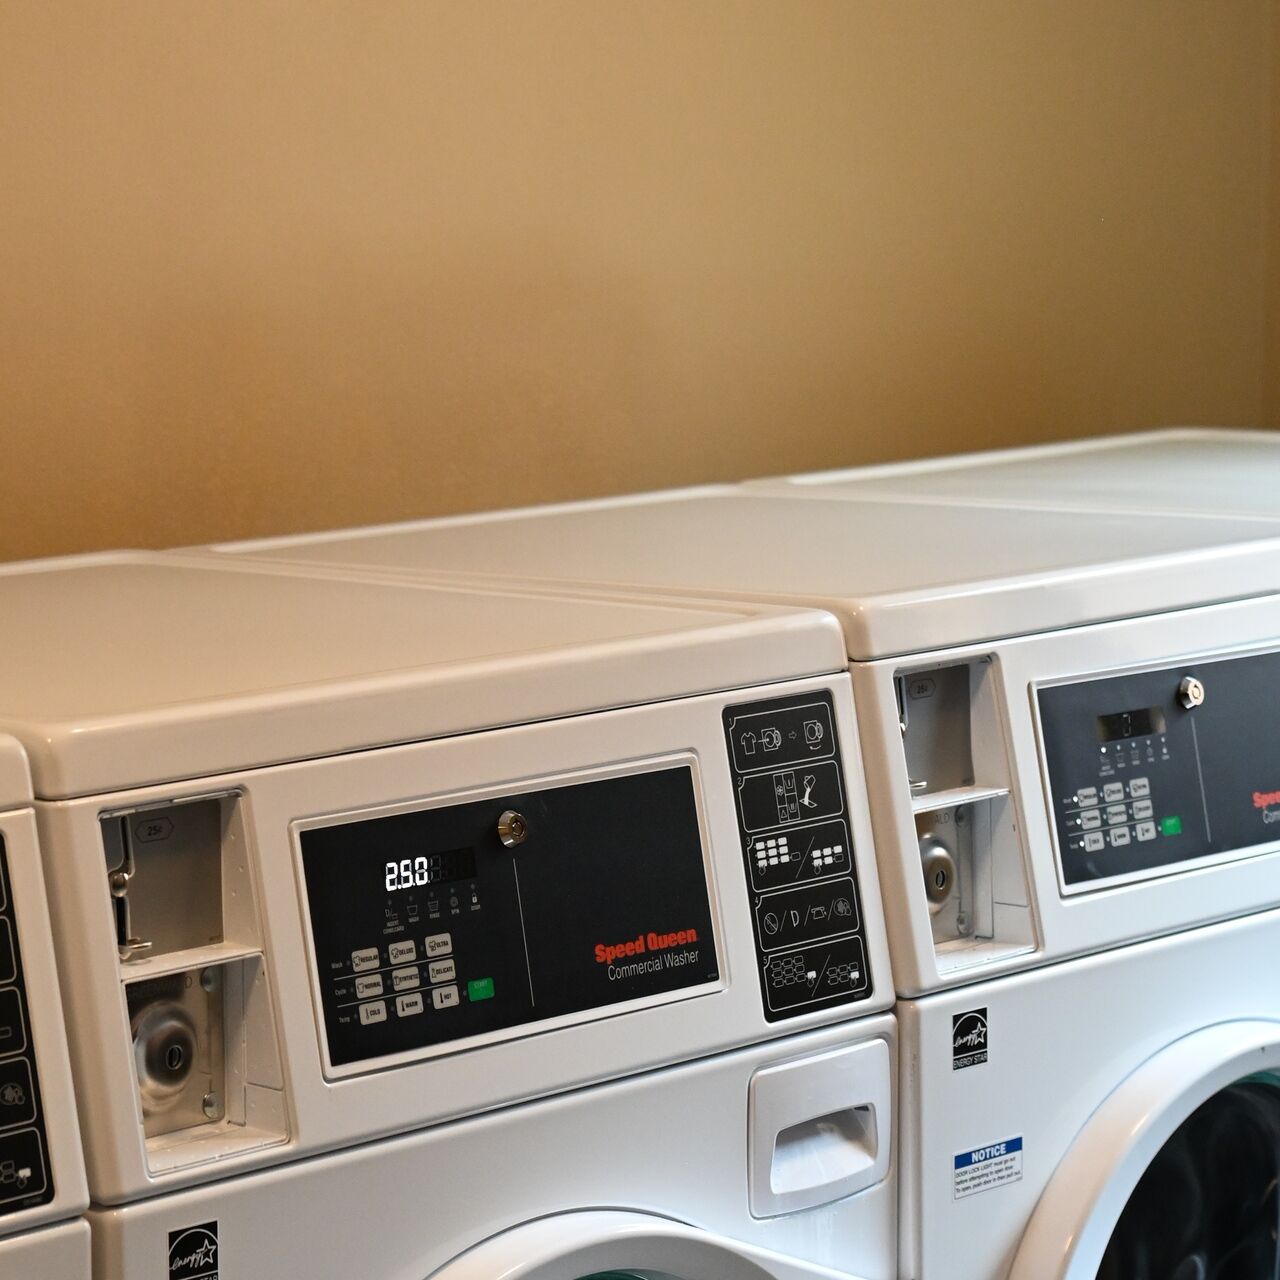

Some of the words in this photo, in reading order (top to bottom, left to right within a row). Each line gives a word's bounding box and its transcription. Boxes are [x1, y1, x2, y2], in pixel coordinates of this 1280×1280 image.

[436, 940, 449, 949] ULTRA
[594, 935, 646, 965] Speed
[646, 928, 698, 951] Queen
[360, 954, 379, 963] REGULAR
[607, 955, 663, 981] Commercial
[664, 949, 700, 969] Washer
[435, 966, 453, 975] DELICATE
[443, 992, 452, 1000] HOT
[405, 1000, 418, 1009] WARM
[369, 1008, 381, 1016] COLD
[953, 1056, 974, 1069] ENERGY
[973, 1052, 987, 1064] STAR
[971, 1143, 1007, 1164] NOTICE
